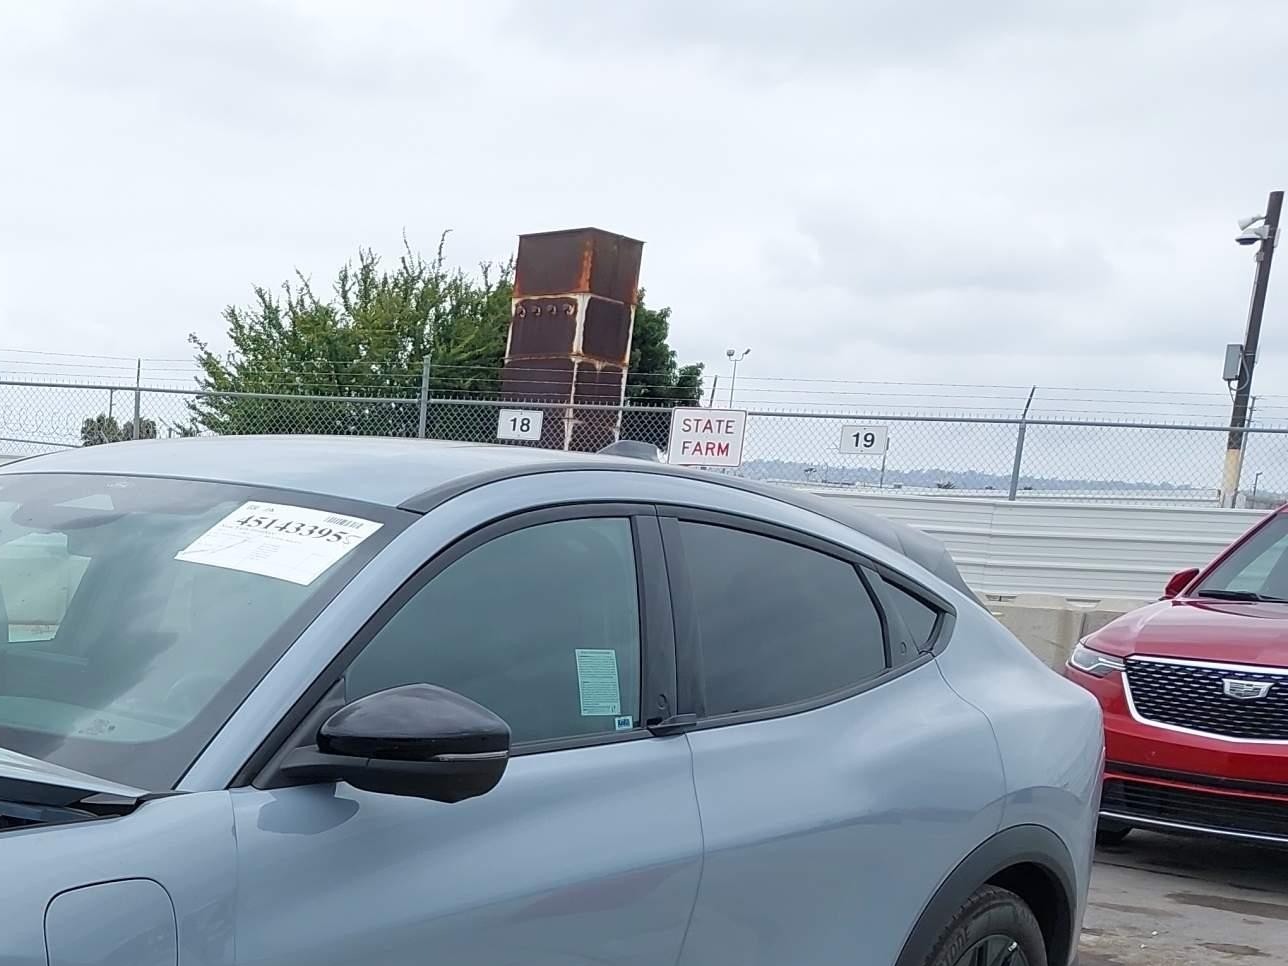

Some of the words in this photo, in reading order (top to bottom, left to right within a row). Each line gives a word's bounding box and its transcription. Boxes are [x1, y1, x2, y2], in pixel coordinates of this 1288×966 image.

[509, 416, 531, 433] 18
[681, 418, 736, 434] STATE
[851, 430, 875, 448] 19
[681, 440, 730, 457] FARM
[236, 514, 350, 544] 45143395
